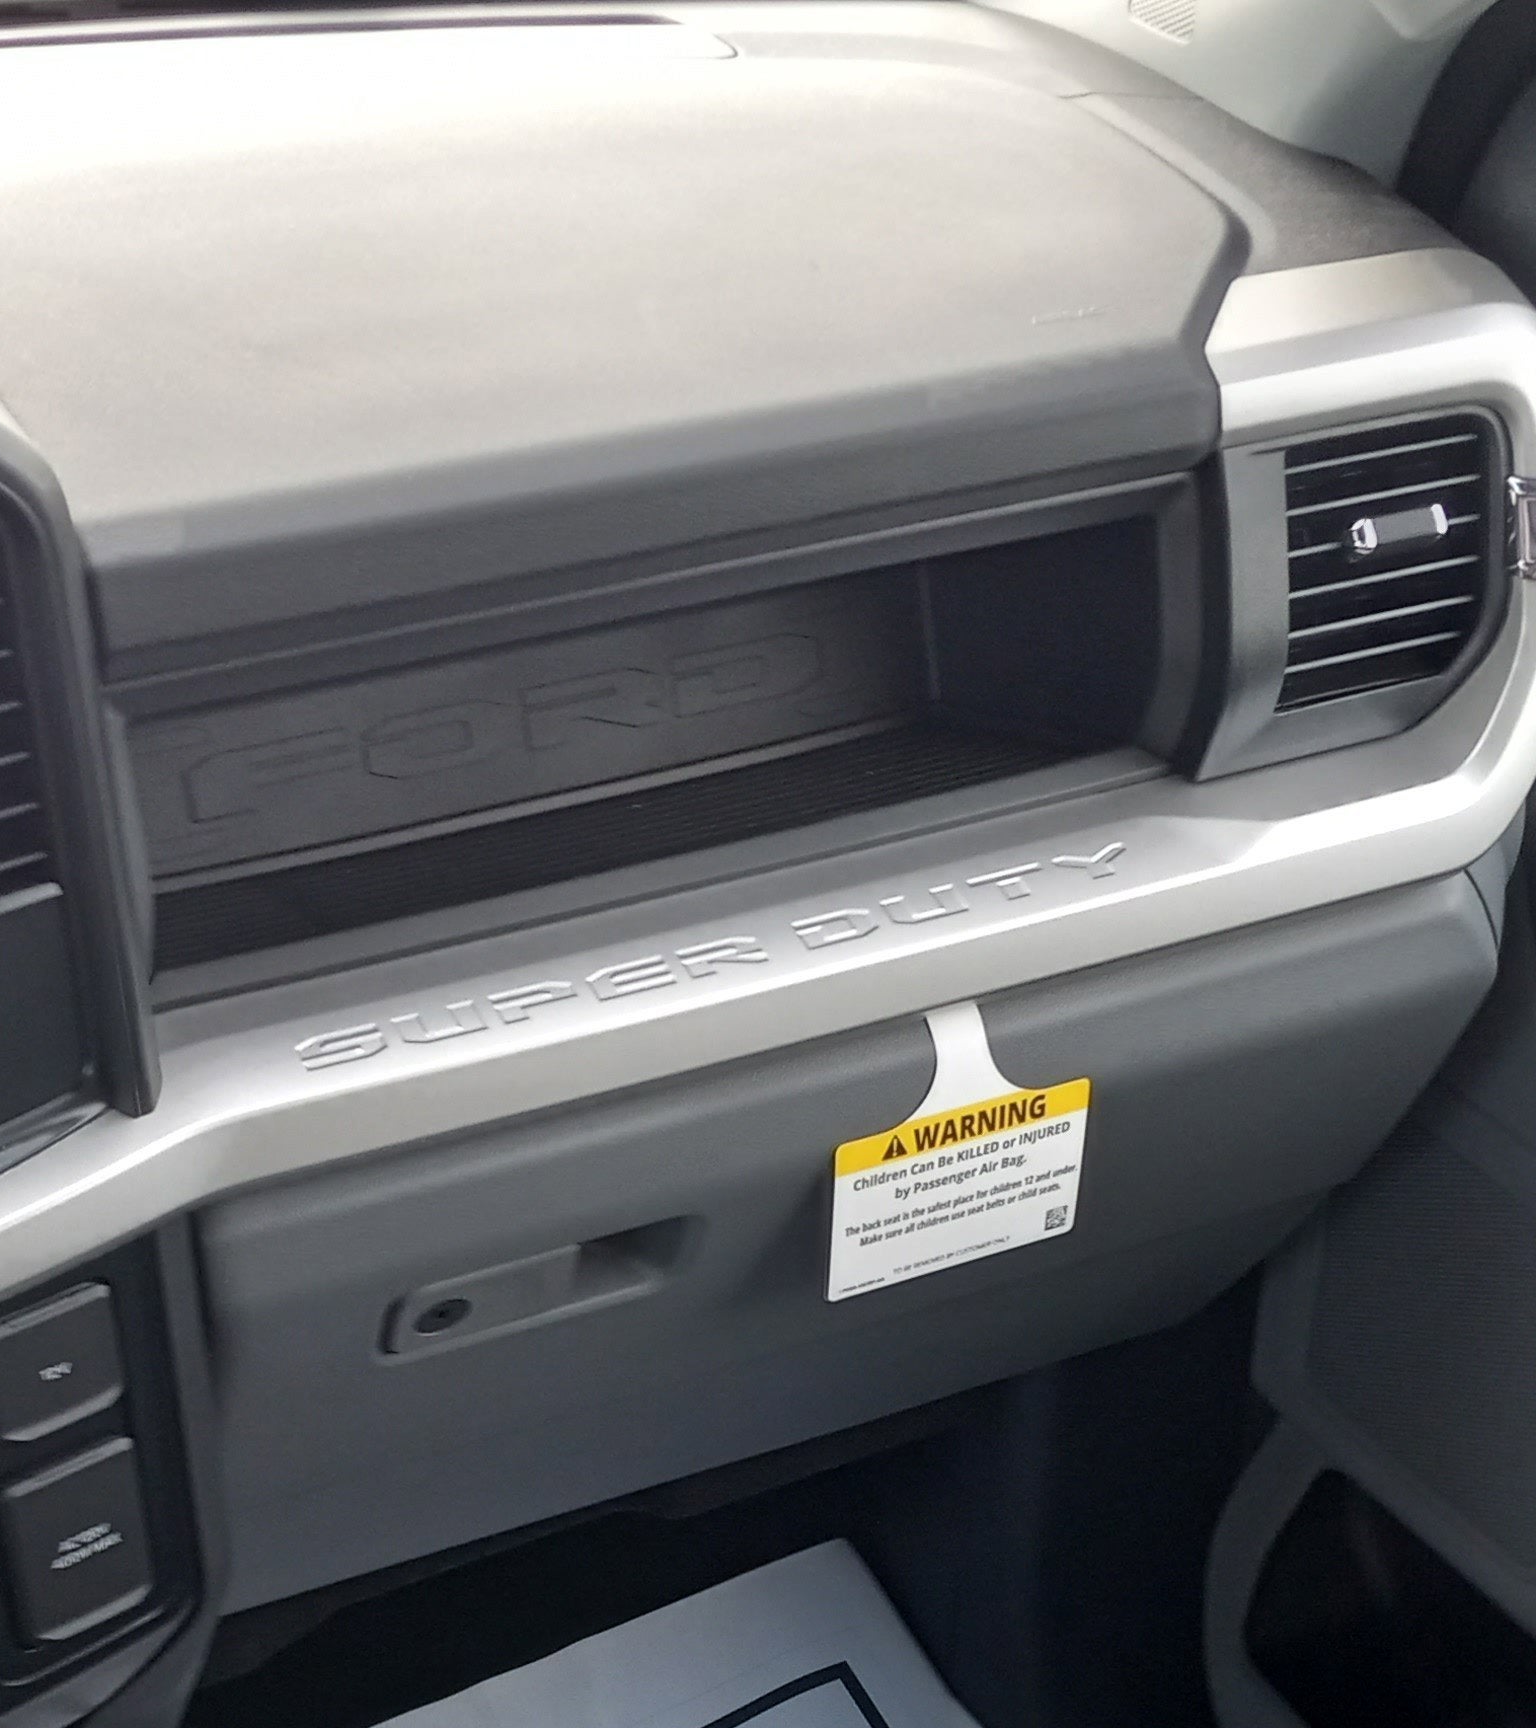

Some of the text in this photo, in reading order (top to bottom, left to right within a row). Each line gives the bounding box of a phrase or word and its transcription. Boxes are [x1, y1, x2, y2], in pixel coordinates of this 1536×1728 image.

[178, 630, 829, 826] FORD
[293, 841, 1127, 1071] SUPER DUTY
[852, 1120, 1072, 1192] Children Can Be KILLED or INJURED
[913, 1093, 1047, 1153] WARNING
[845, 1164, 1078, 1237] The back seat is the safest place for children 12 and under.
[894, 1154, 1028, 1201] by Passenger Air Bag.
[859, 1182, 1062, 1247] Make sure all children use seat belts or child seats.
